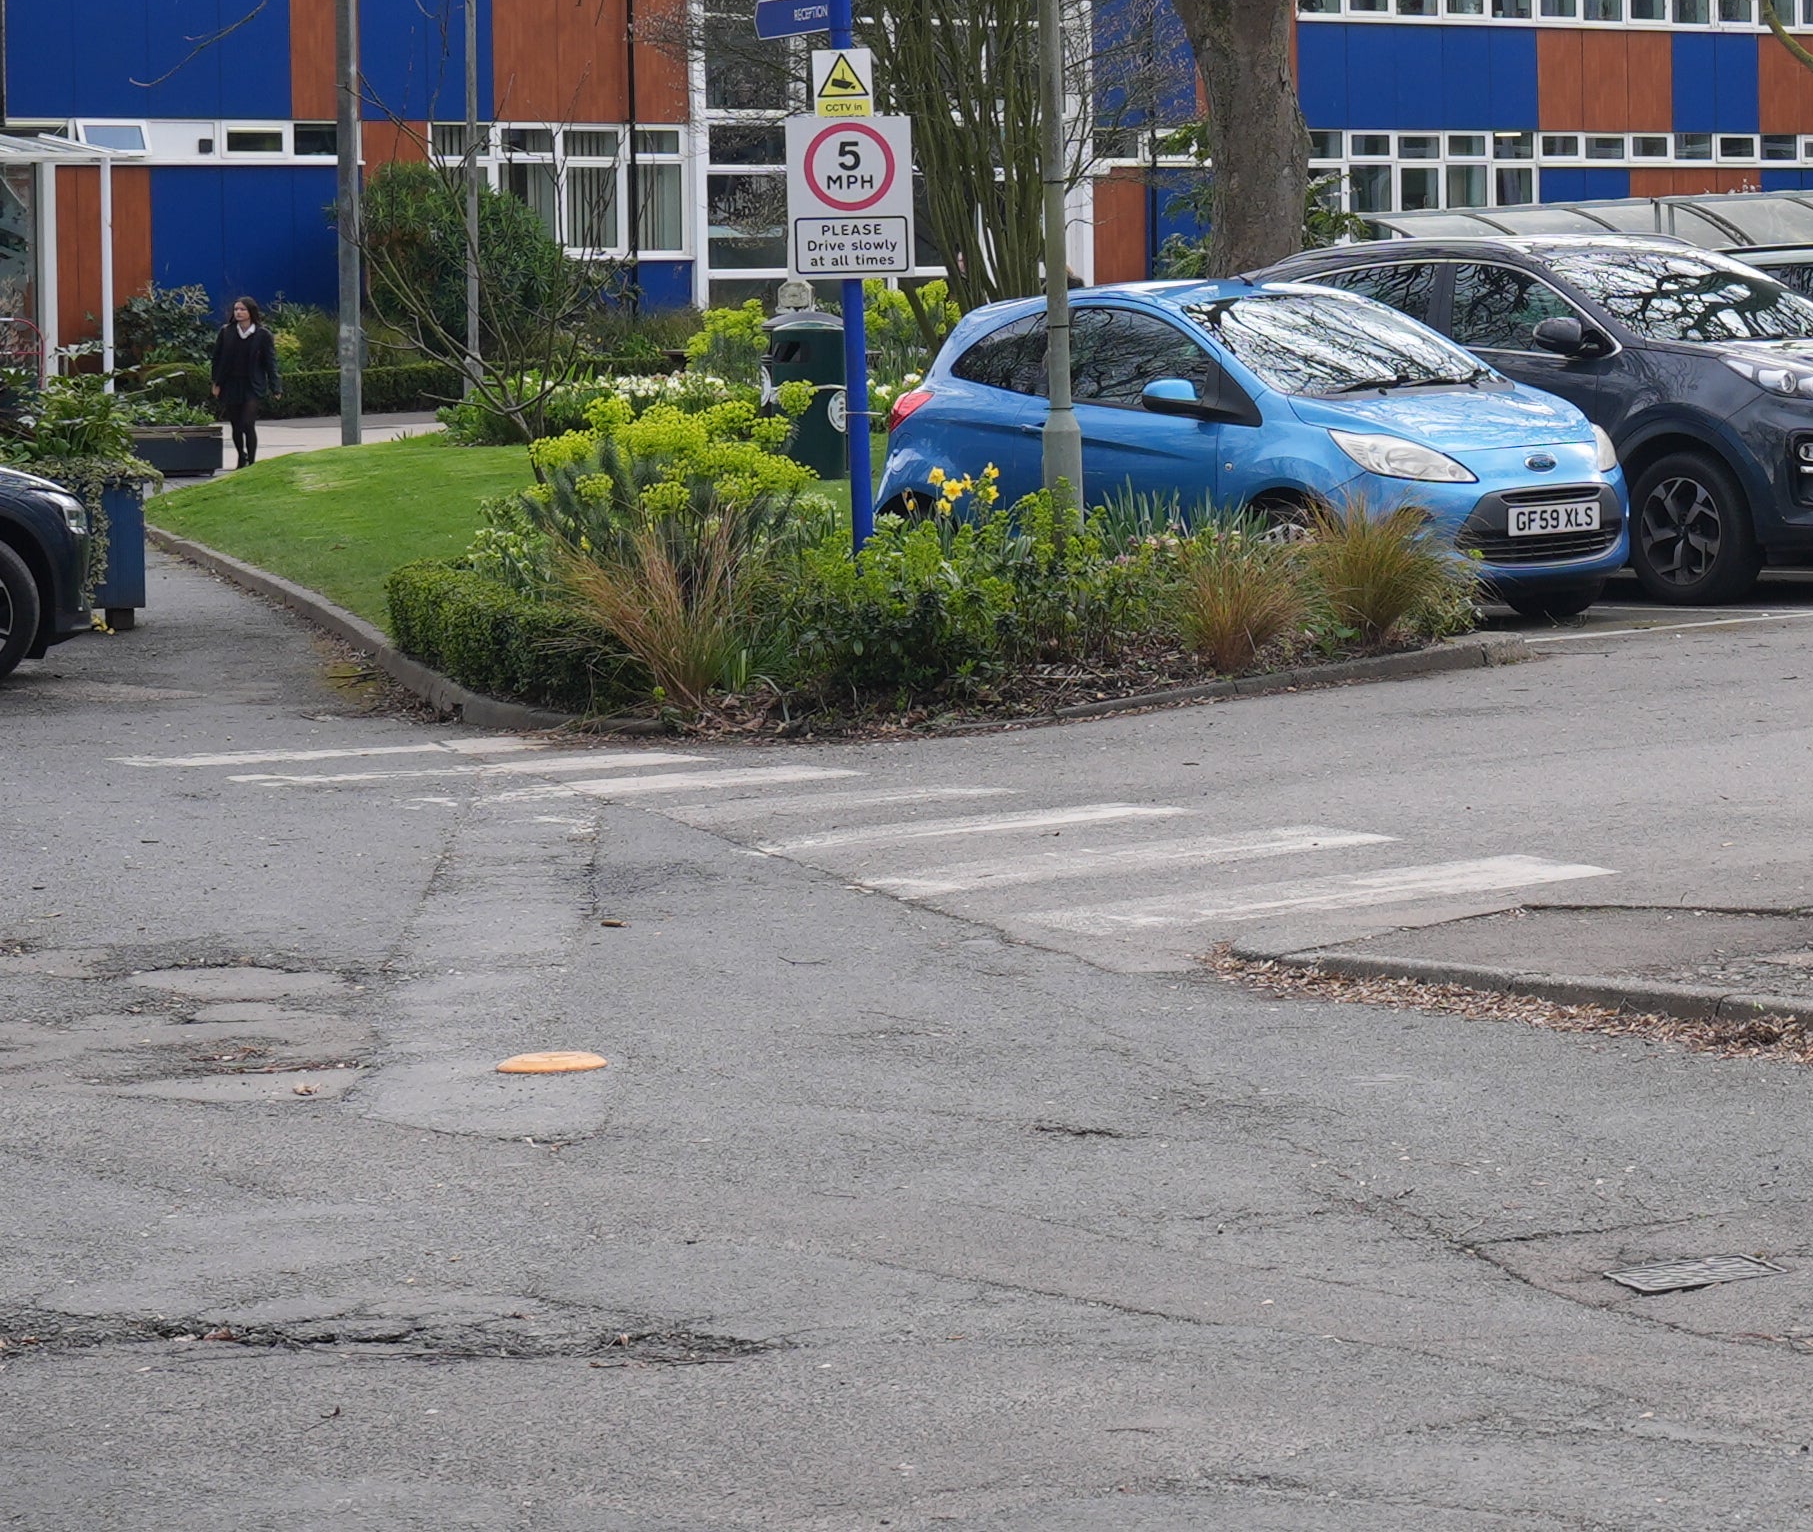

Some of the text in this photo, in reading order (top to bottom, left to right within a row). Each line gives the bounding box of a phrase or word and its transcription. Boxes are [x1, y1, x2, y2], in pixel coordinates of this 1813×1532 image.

[825, 101, 863, 113] CCTV in
[838, 140, 861, 172] 5
[826, 174, 874, 190] MPH
[821, 223, 883, 236] PLEASE
[806, 238, 898, 253] Drive slowly
[810, 251, 895, 267] at all times
[1516, 506, 1594, 532] GF59 XLS
